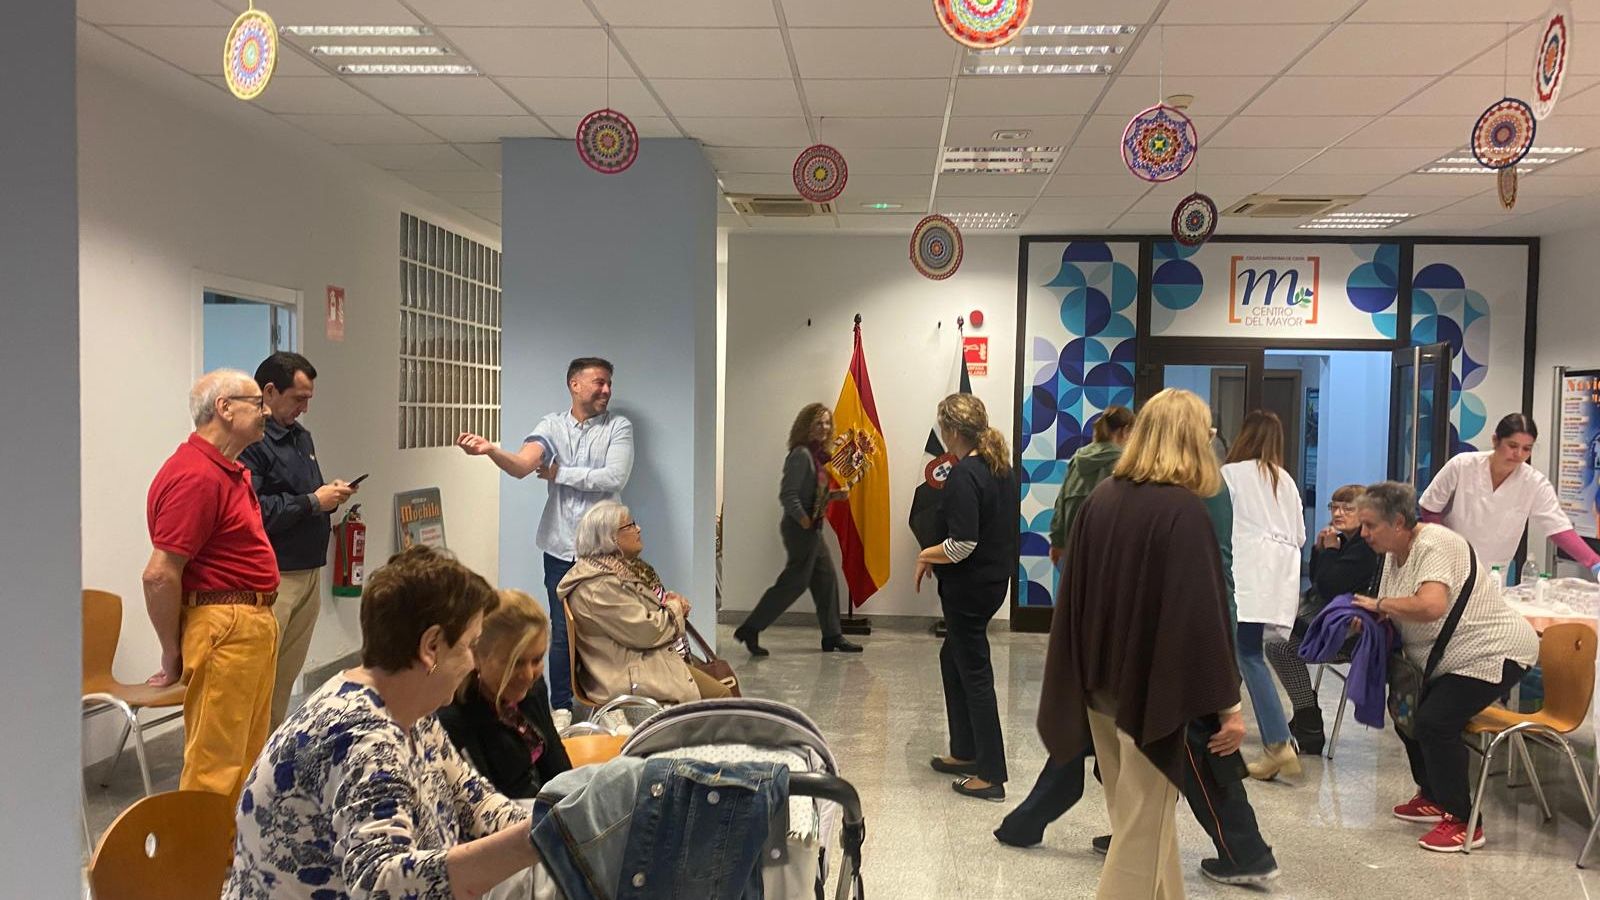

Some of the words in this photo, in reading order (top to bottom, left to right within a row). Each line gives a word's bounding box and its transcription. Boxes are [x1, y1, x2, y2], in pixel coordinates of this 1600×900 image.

[1252, 307, 1293, 316] CENTRO
[1245, 317, 1263, 326] DEL
[1265, 317, 1303, 326] MAYOR
[401, 502, 440, 523] Mochila
